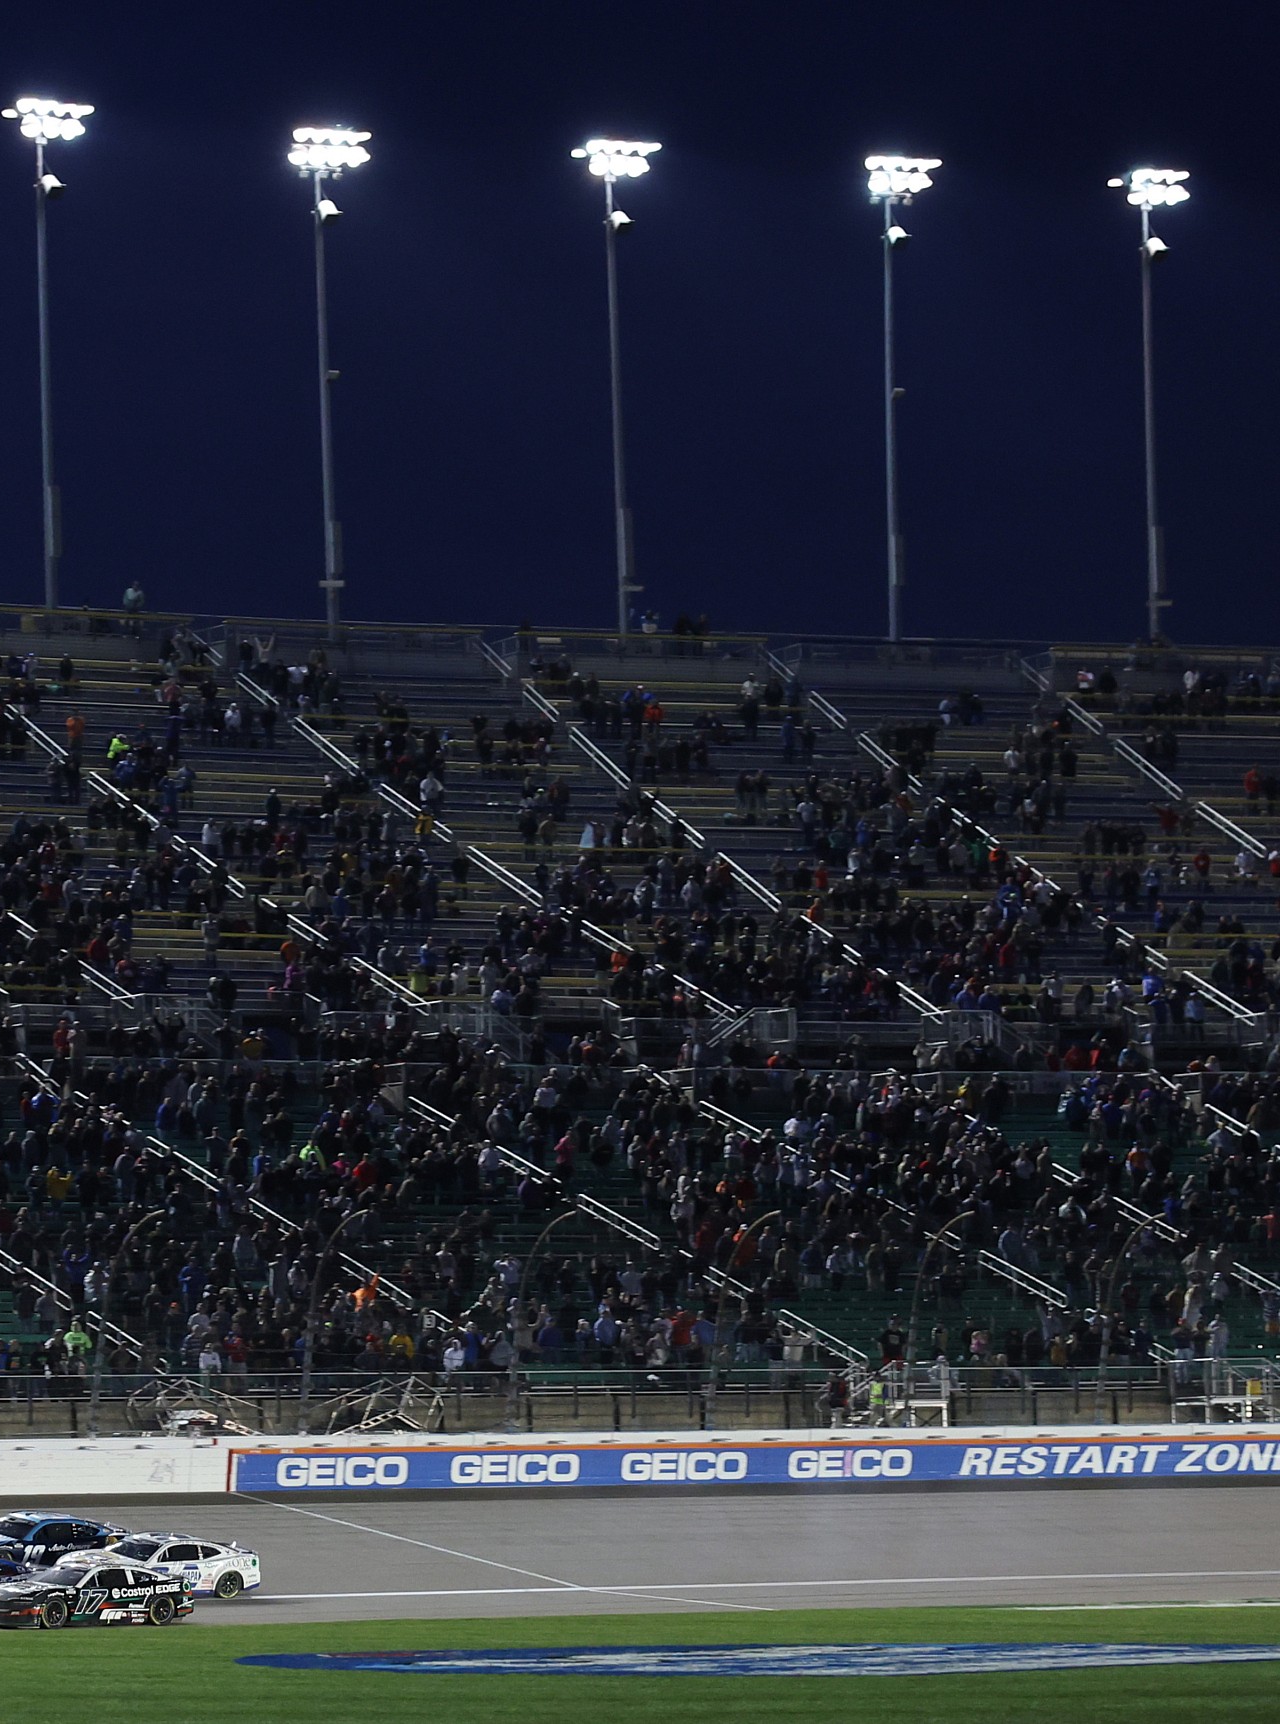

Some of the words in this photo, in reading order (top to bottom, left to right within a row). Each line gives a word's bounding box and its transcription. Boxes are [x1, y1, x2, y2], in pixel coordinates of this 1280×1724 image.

[277, 1456, 409, 1487] GEICO
[450, 1453, 580, 1484] GEICO
[621, 1451, 749, 1481] GEICO
[788, 1448, 913, 1479] GEICO
[959, 1444, 1169, 1476] RESTART
[22, 1544, 46, 1565] 19
[74, 1588, 109, 1615] 17
[121, 1584, 154, 1598] Castrol
[156, 1582, 181, 1594] EDGE
